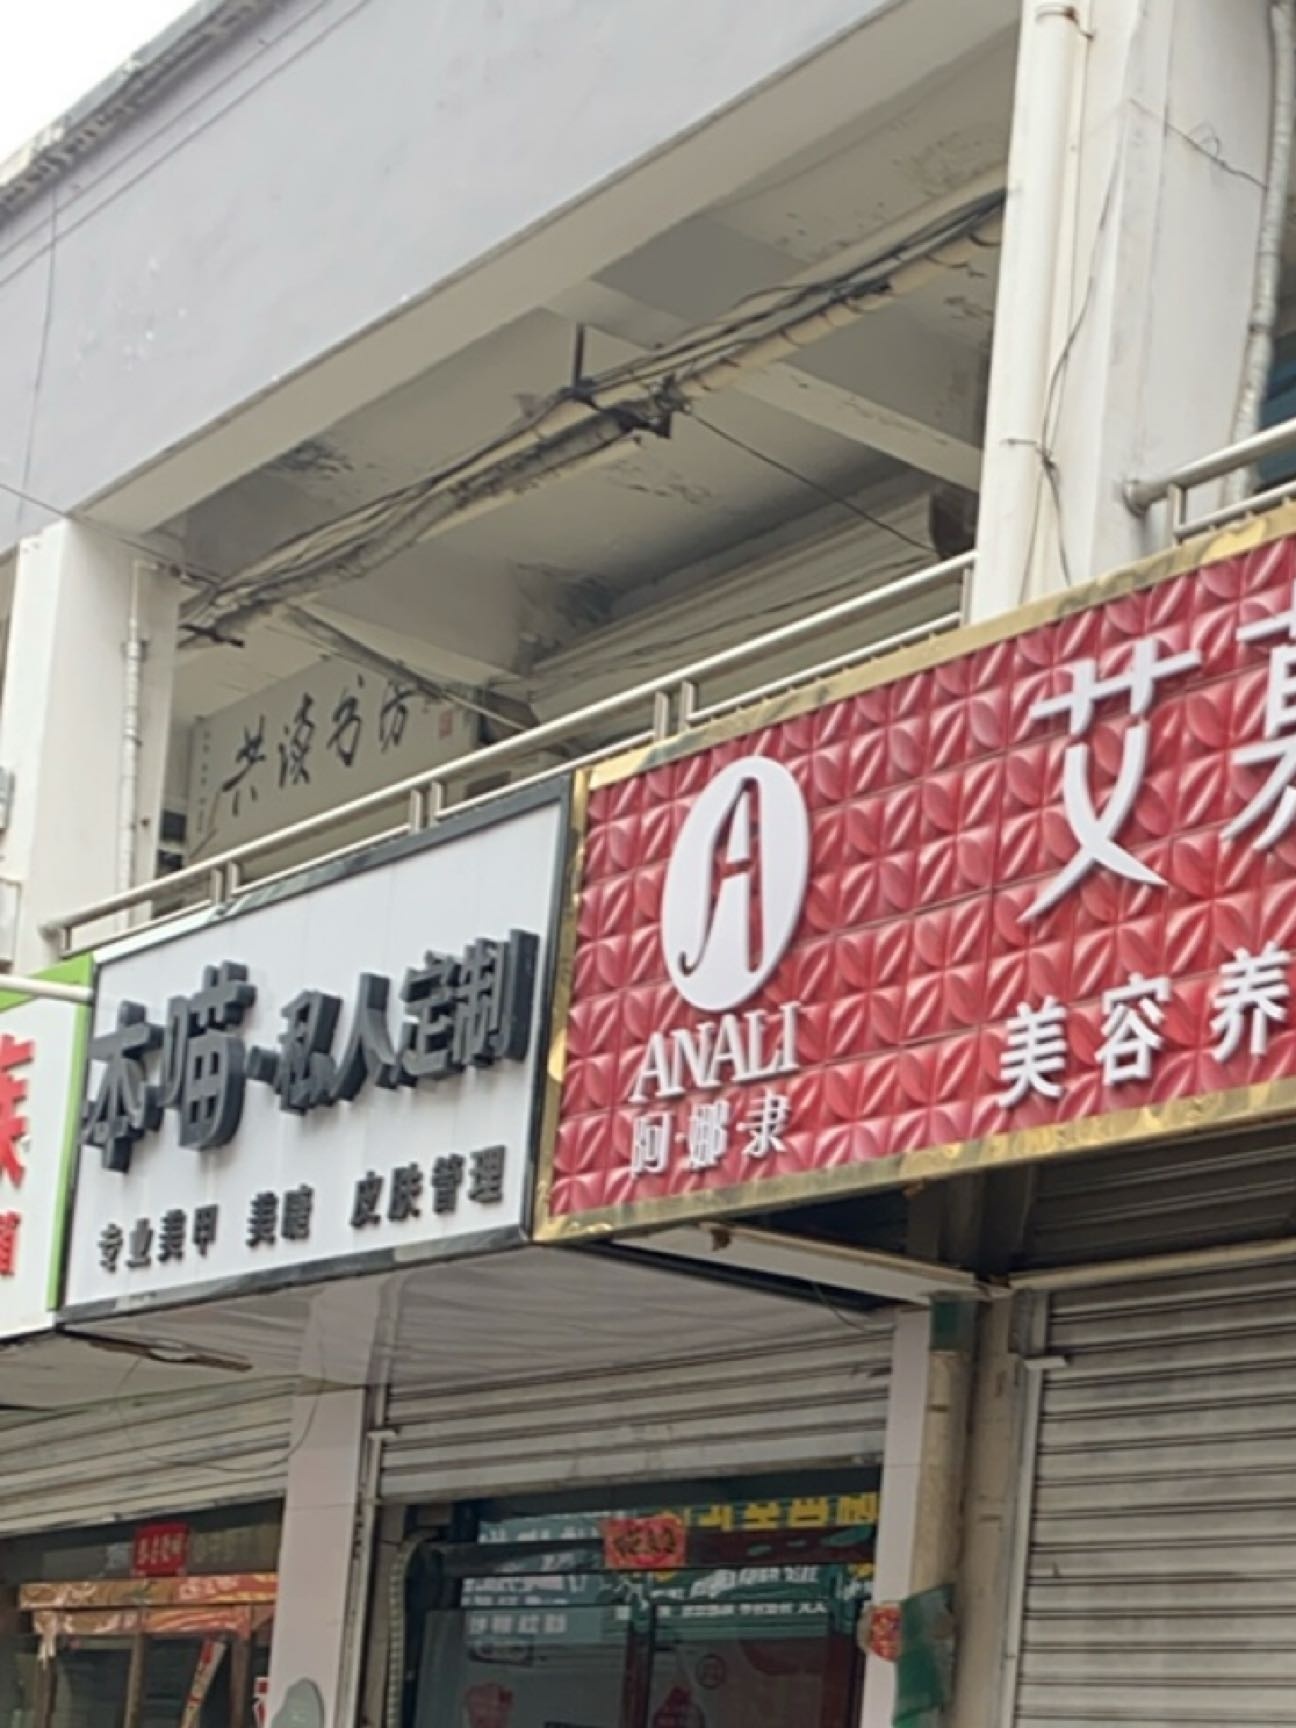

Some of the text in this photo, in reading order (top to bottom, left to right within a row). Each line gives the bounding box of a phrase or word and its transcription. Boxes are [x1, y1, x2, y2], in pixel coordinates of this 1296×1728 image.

[628, 1001, 802, 1104] ANALI
[98, 1203, 219, 1273] 专业美甲
[350, 1145, 507, 1229] 皮肤管理
